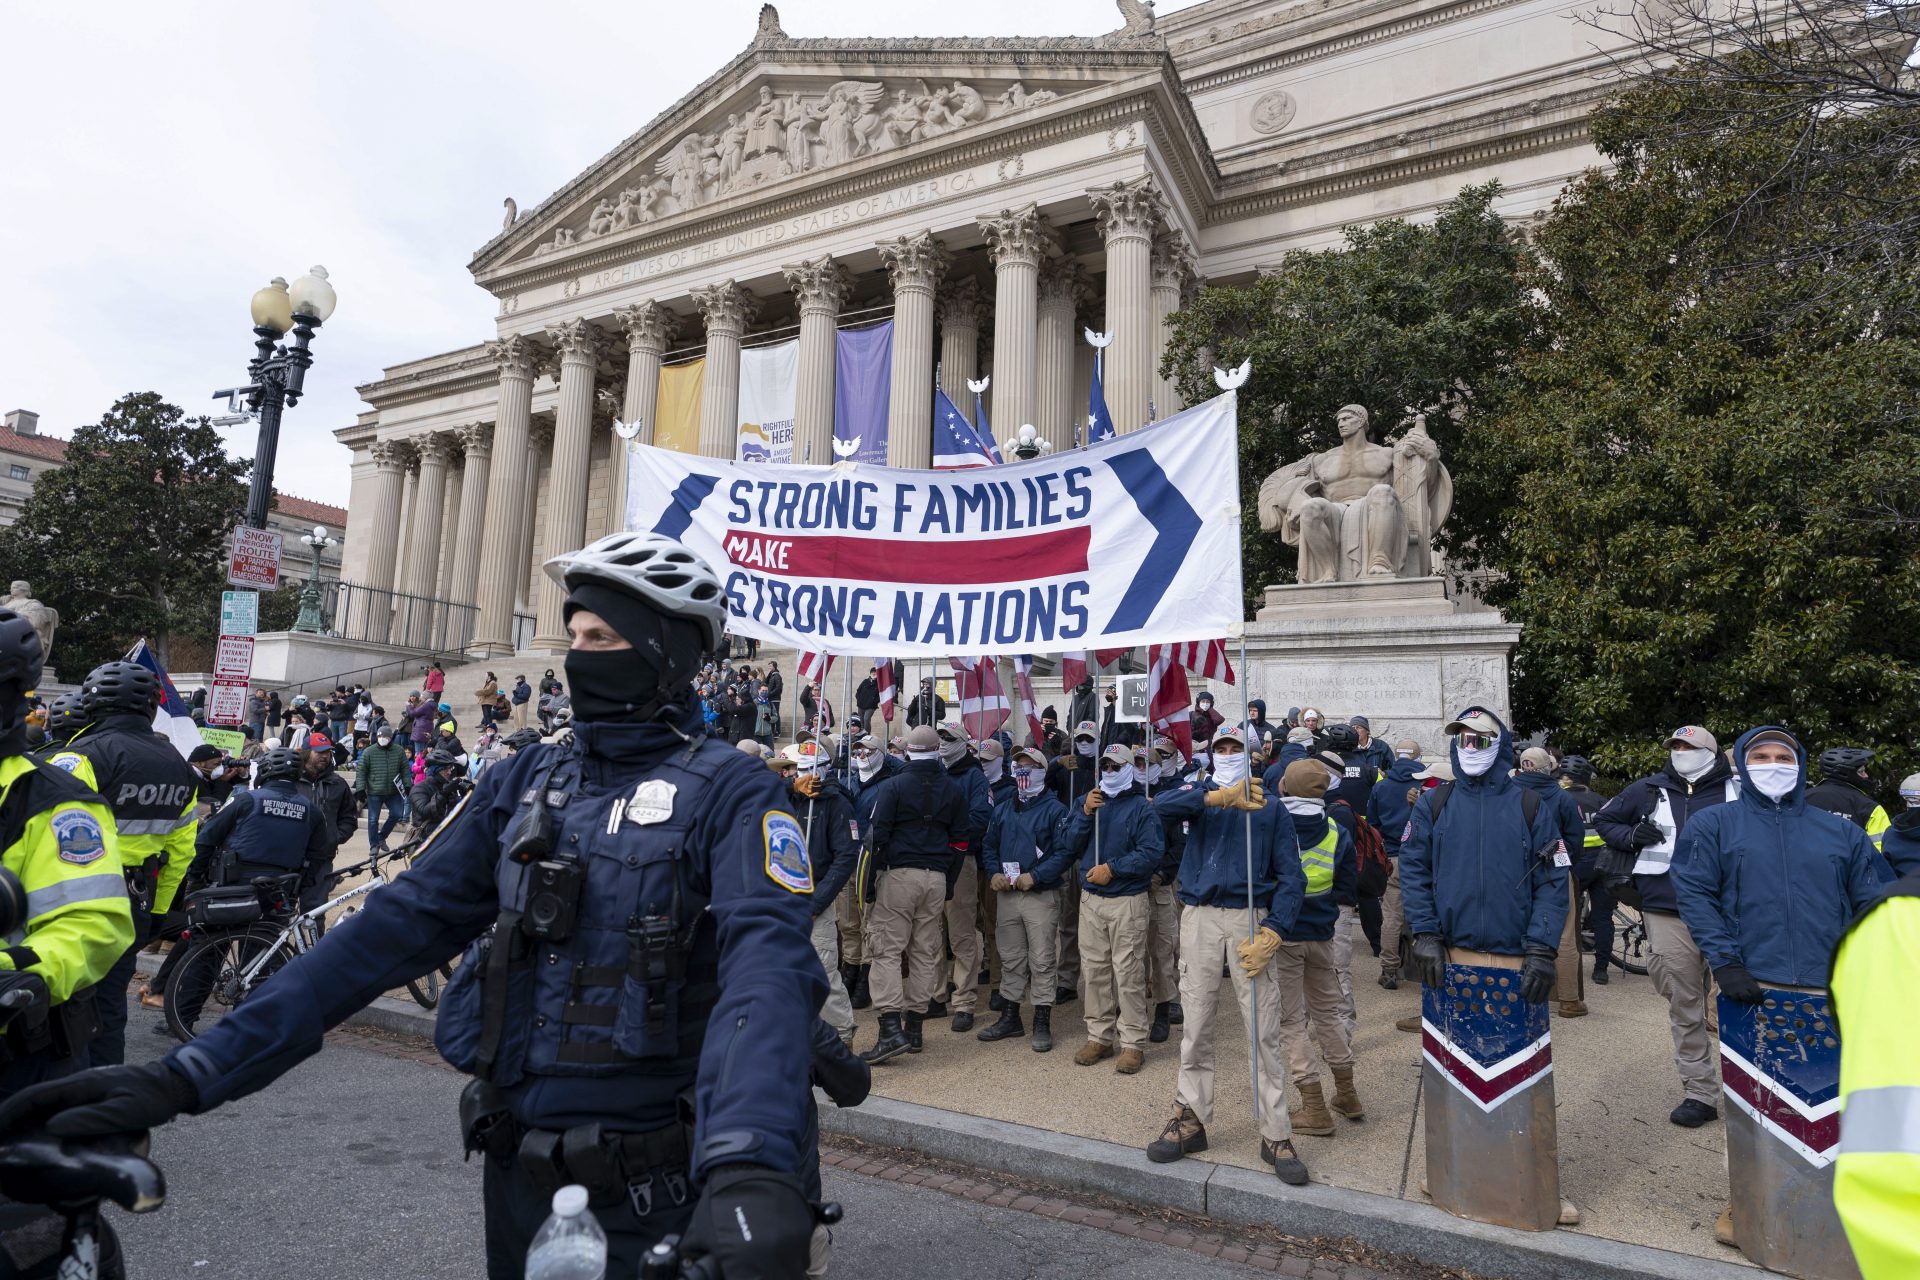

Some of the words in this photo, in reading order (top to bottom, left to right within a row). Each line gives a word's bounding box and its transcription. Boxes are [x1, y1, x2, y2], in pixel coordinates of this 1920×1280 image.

[593, 256, 664, 289] ARCHIVES
[668, 250, 687, 268] OF
[693, 242, 720, 260] THE
[725, 224, 786, 252] UNITED
[790, 206, 850, 236] STATES
[856, 197, 880, 217] OF
[884, 172, 977, 210] AMERICA
[728, 479, 878, 532] STRONG
[893, 466, 1092, 534] FAMILIES
[244, 530, 274, 543] SNOW
[236, 538, 280, 550] EMERGENCY
[240, 546, 275, 560] ROUTE
[726, 536, 793, 570] MAKE
[234, 554, 246, 562] NO
[248, 556, 276, 568] PARKING
[242, 564, 268, 574] DURING
[233, 570, 274, 584] EMERGENCY
[725, 571, 877, 638] STRONG
[888, 580, 1090, 645] NATIONS
[1278, 691, 1288, 699] IS
[1354, 690, 1370, 699] OF
[263, 800, 306, 813] METROPOLITAN
[264, 807, 303, 819] POLICE
